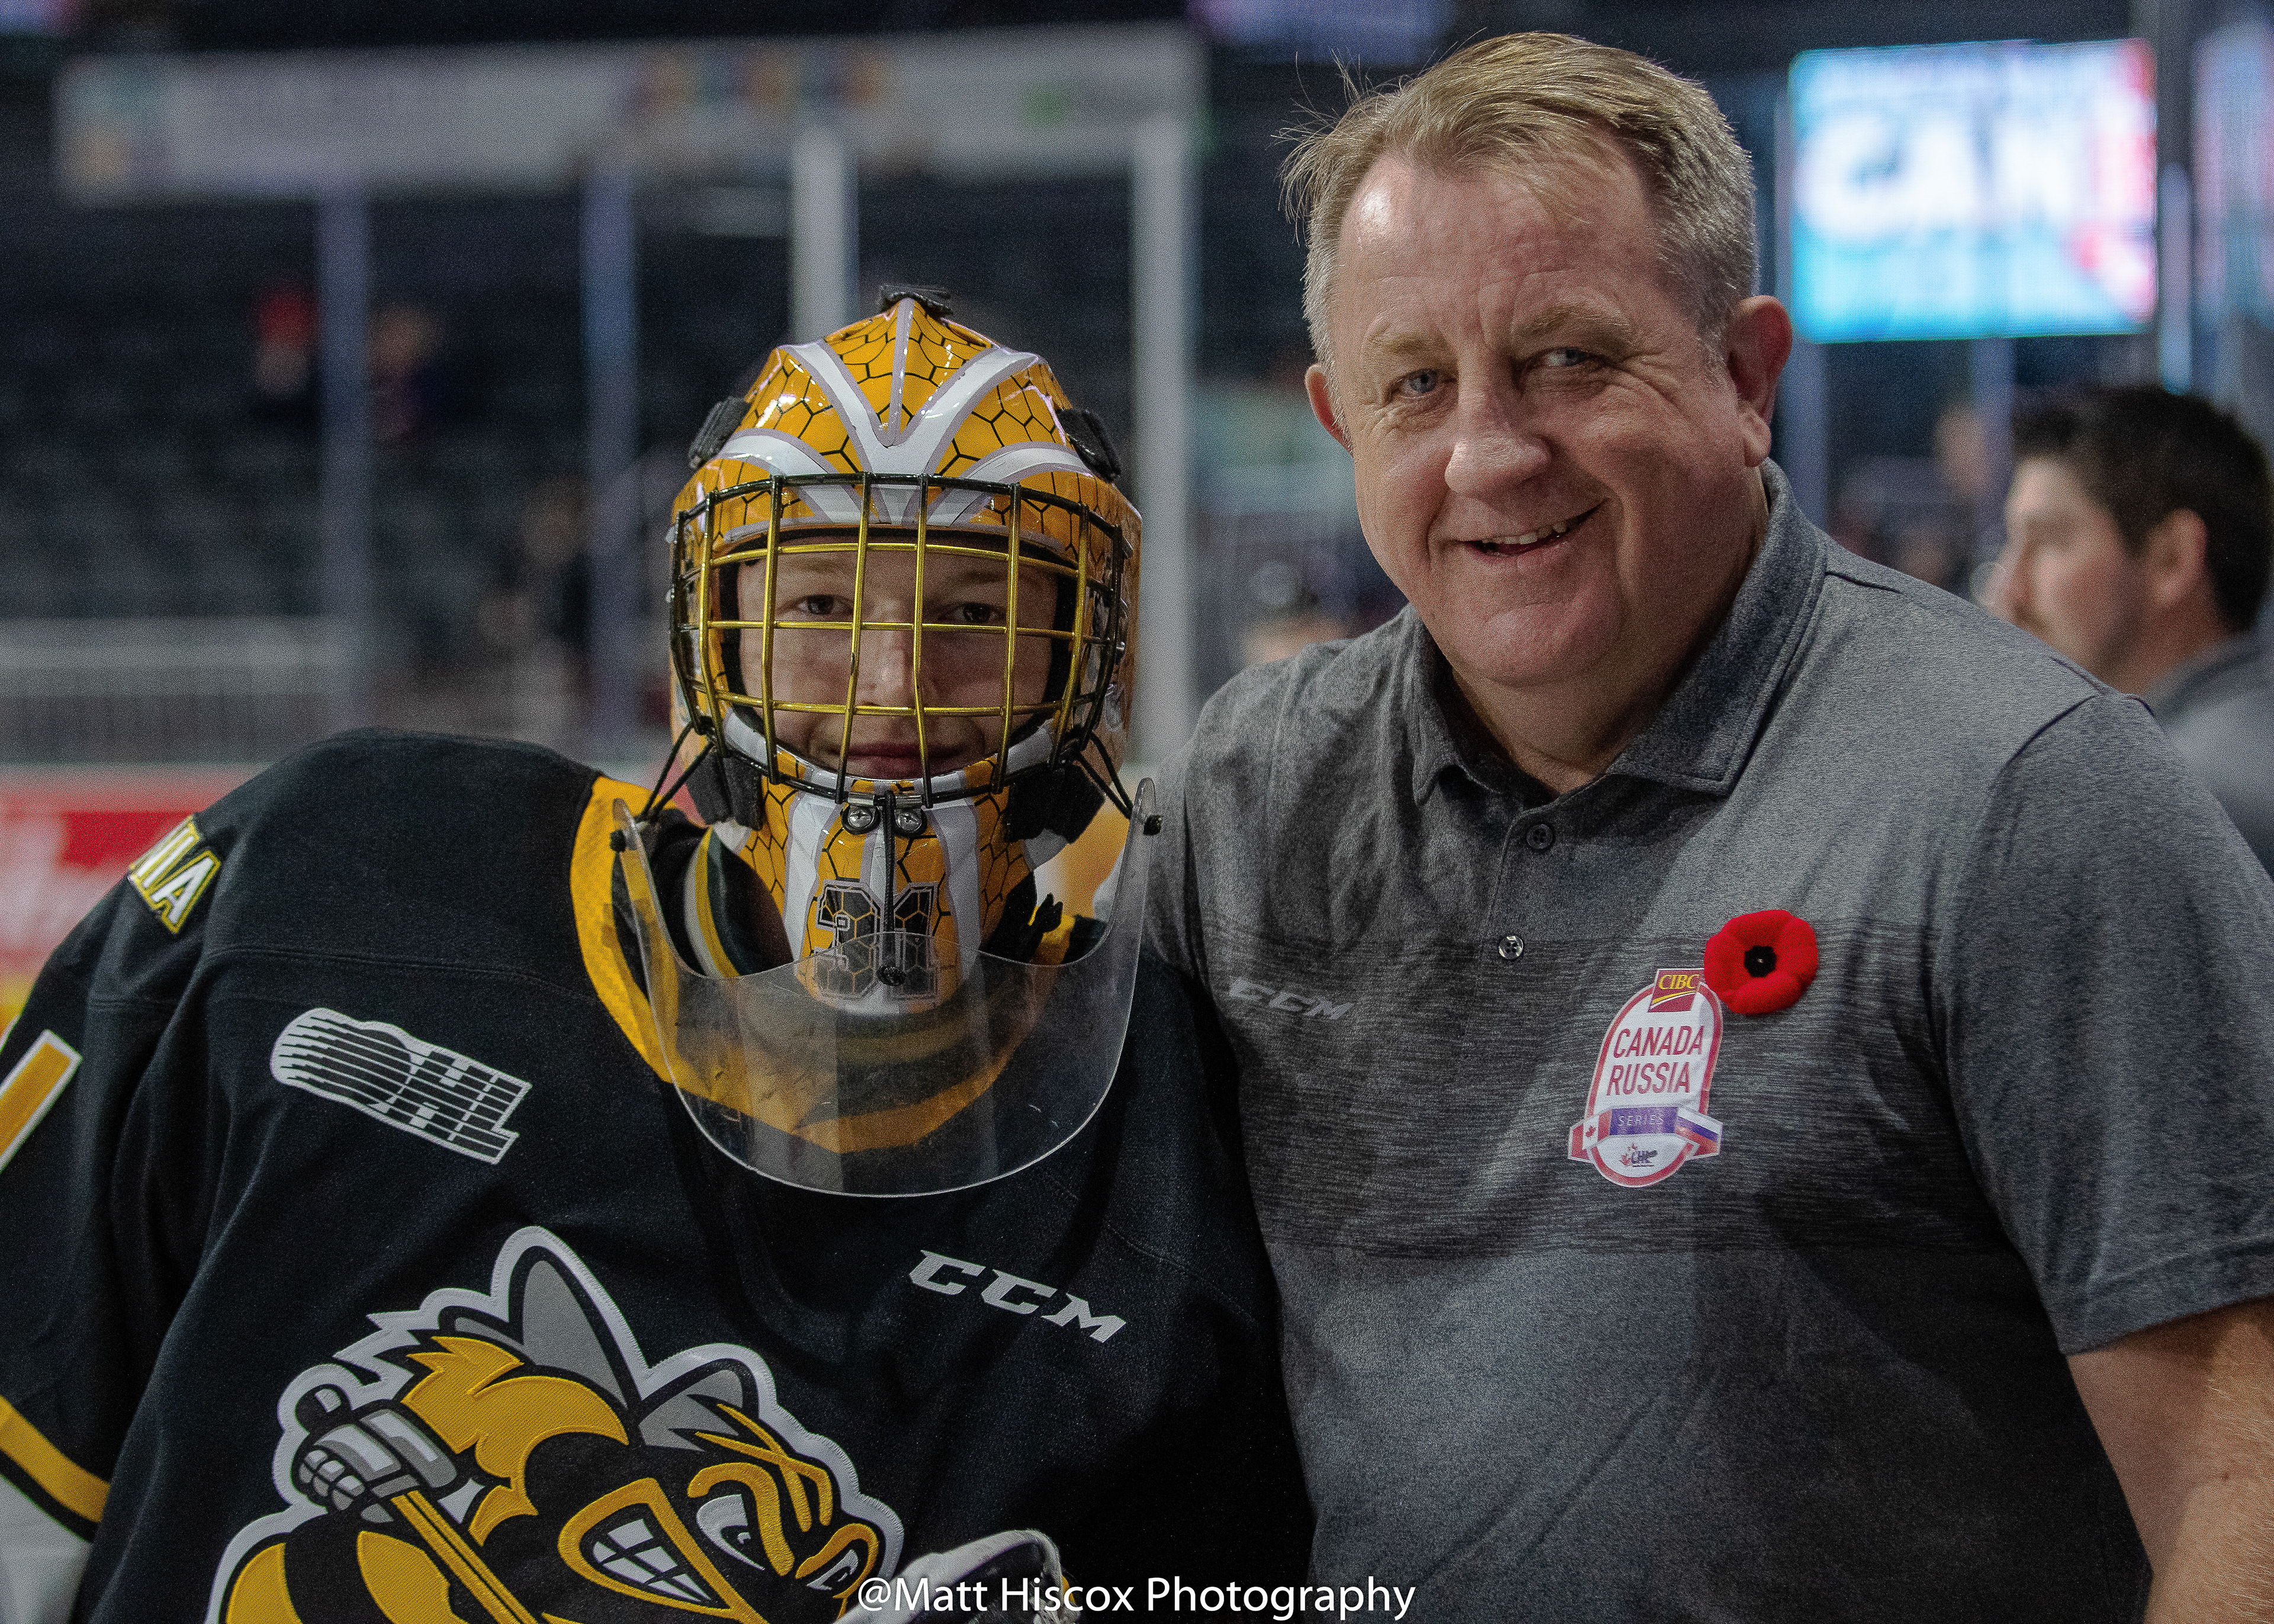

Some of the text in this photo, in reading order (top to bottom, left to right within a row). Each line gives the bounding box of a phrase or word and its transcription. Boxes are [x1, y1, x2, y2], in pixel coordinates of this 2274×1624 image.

[1229, 976, 1354, 1020] CCM
[1659, 974, 1699, 990] CIBC
[1613, 1025, 1704, 1059] CANADA
[1607, 1062, 1690, 1096] RUSSIA
[1617, 1114, 1664, 1127] SERIES
[908, 1249, 1126, 1343] CCM
